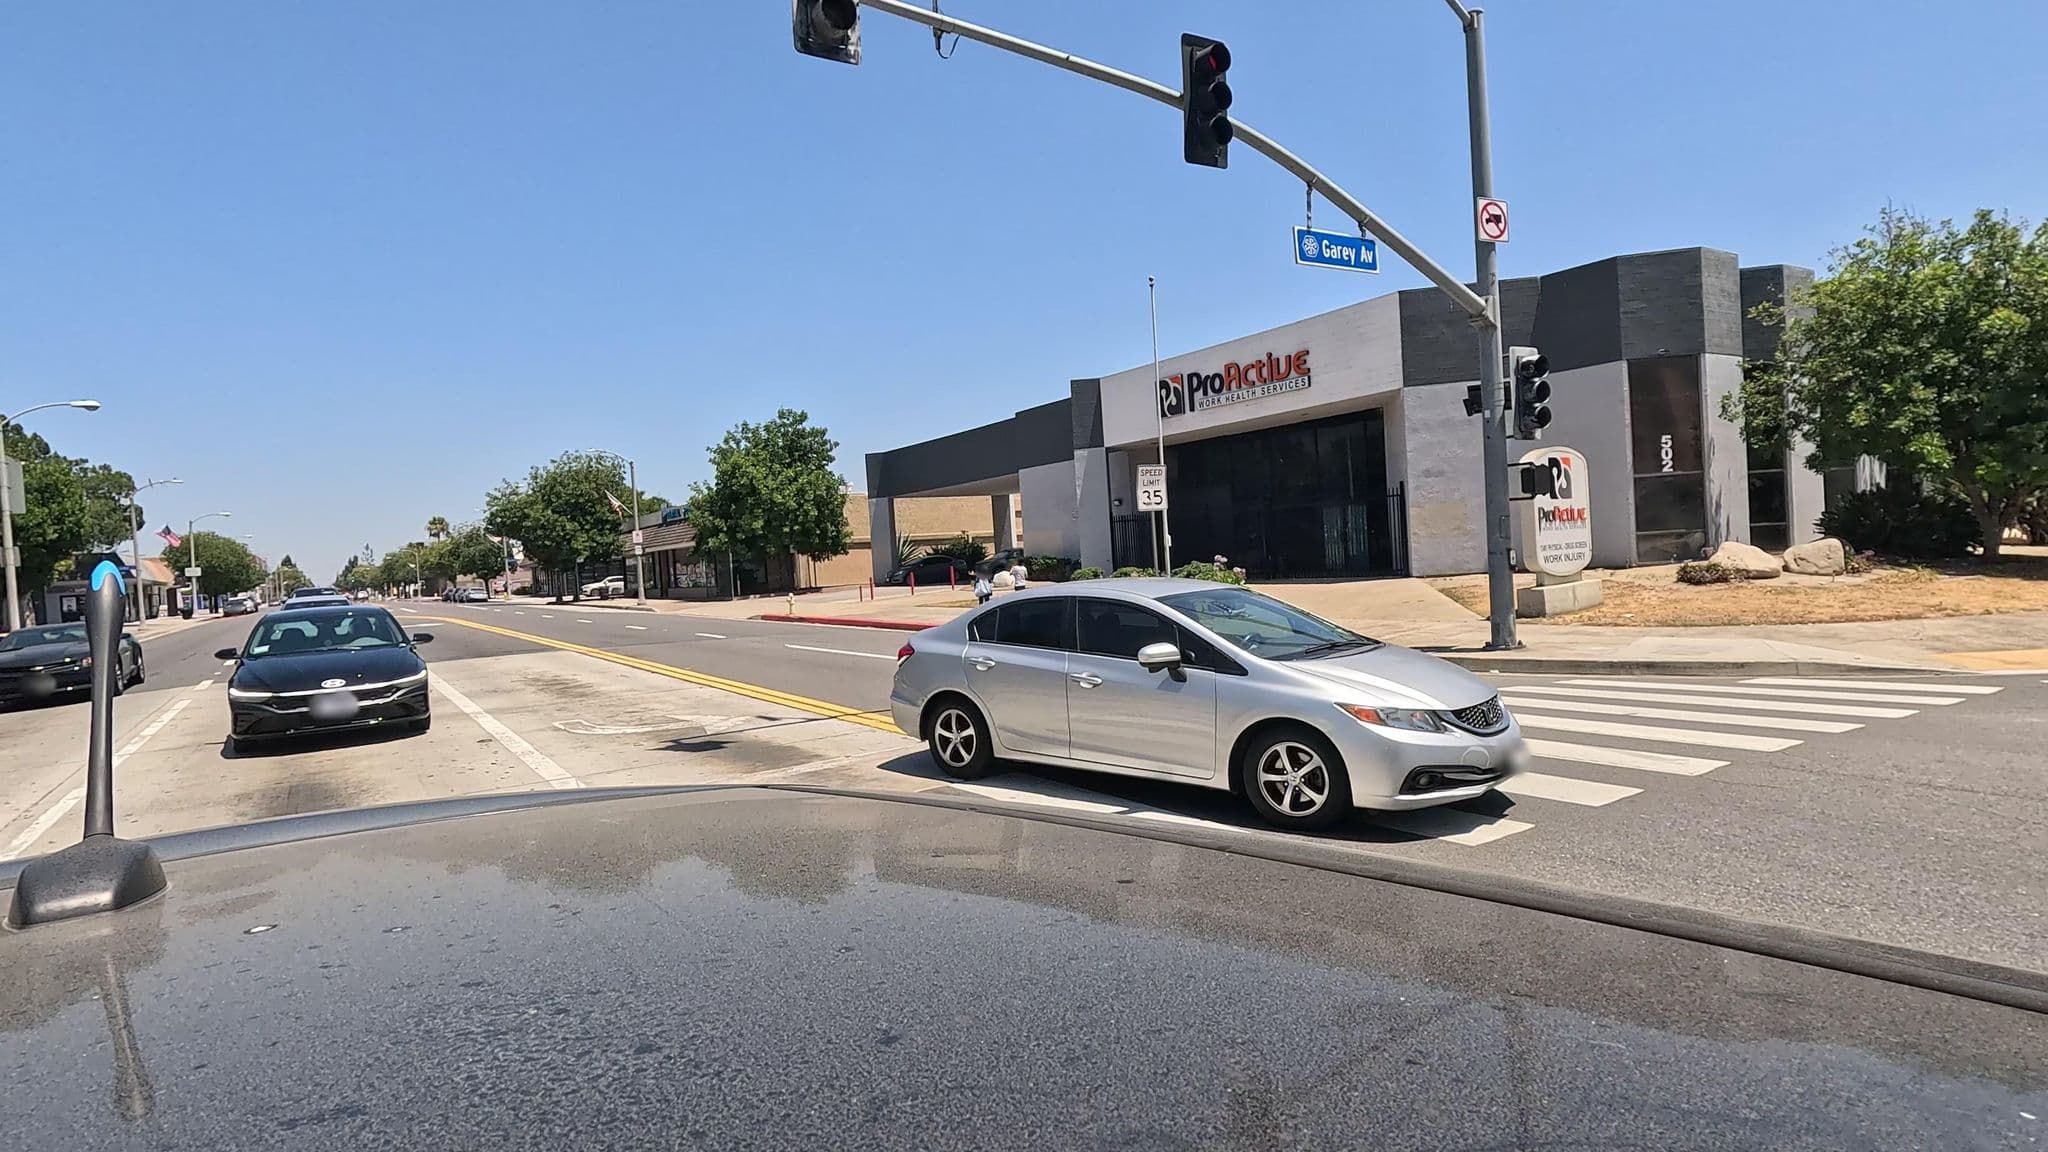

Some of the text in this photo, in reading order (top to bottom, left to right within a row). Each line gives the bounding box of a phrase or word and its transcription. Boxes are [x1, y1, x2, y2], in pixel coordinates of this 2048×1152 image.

[1322, 240, 1374, 265] Garey Av
[1187, 350, 1311, 412] ProActive
[1199, 378, 1307, 409] WORK HEALTH SERVICES
[1661, 434, 1673, 472] 502
[1140, 469, 1163, 477] SPEED
[1143, 479, 1160, 487] LIMIT
[1142, 490, 1163, 506] 35
[1543, 552, 1586, 564] WORK INJURY
